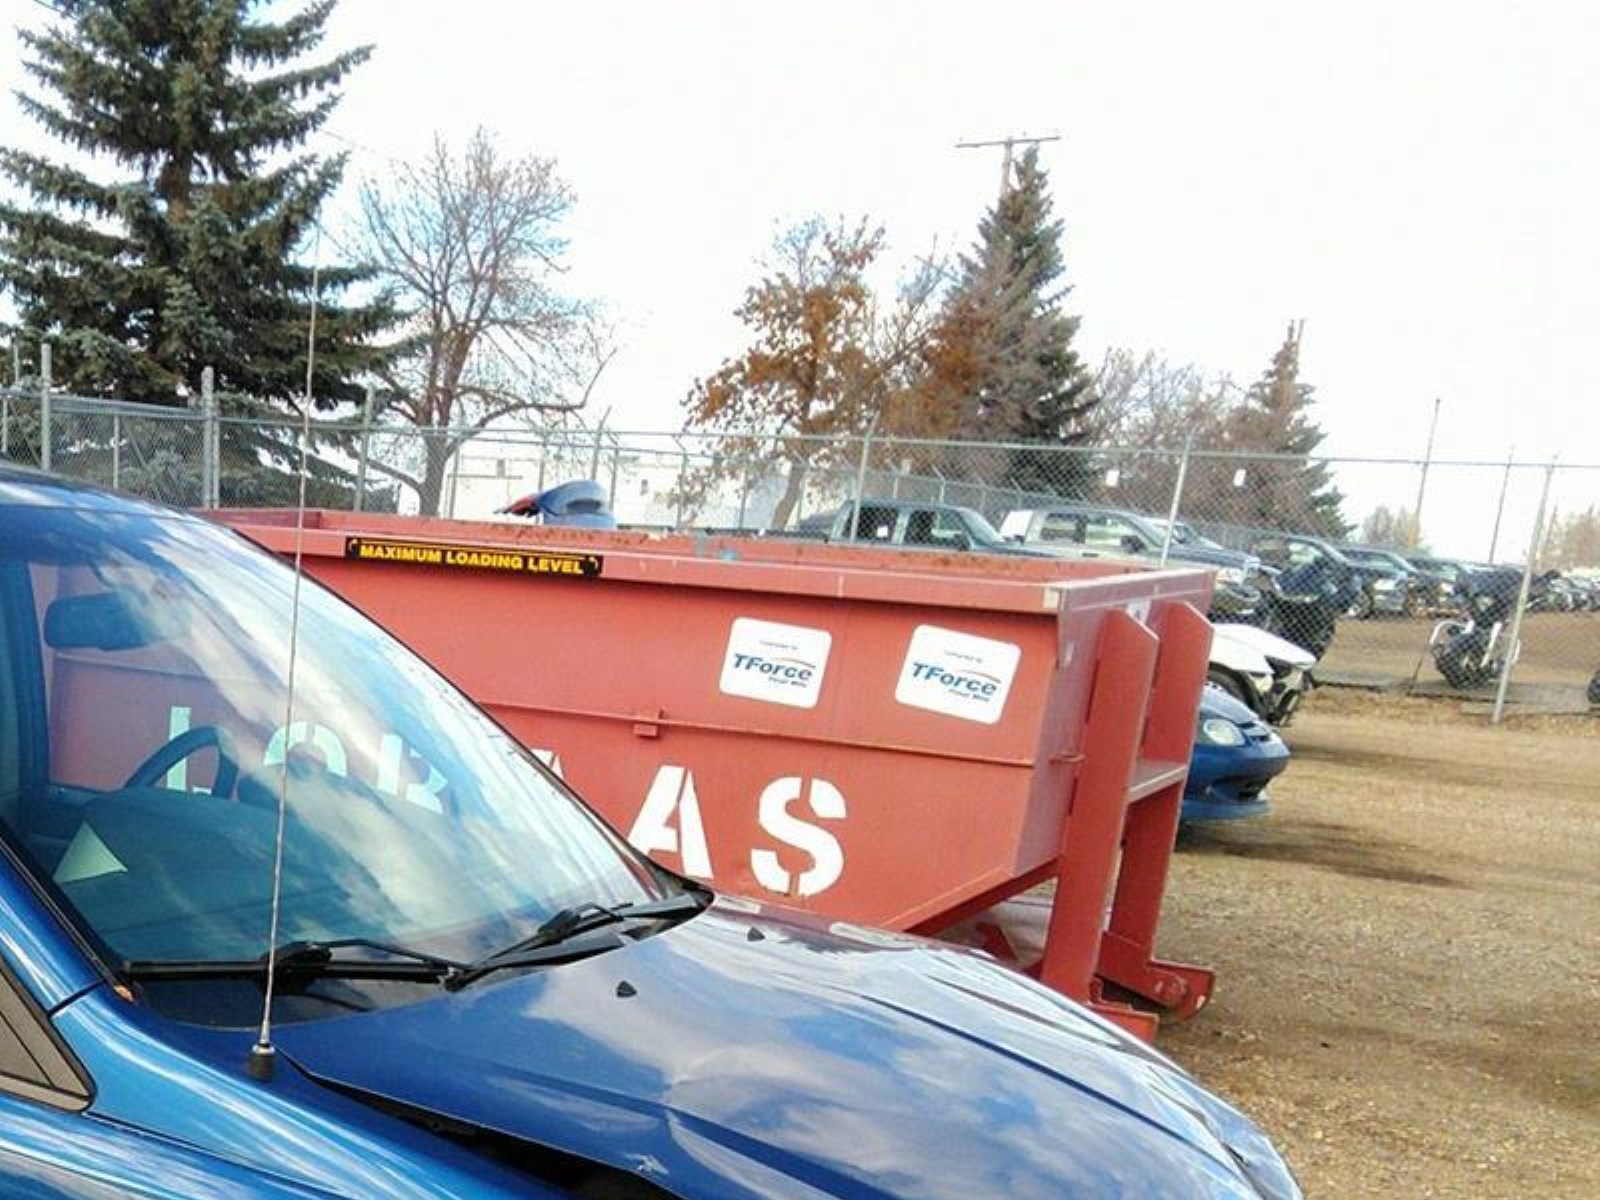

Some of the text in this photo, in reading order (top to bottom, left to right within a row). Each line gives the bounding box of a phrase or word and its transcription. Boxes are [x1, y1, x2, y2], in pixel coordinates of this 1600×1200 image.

[359, 545, 584, 574] MAXIMUM LOADING LEVEL
[734, 653, 813, 681] TForce
[911, 662, 997, 696] TForce
